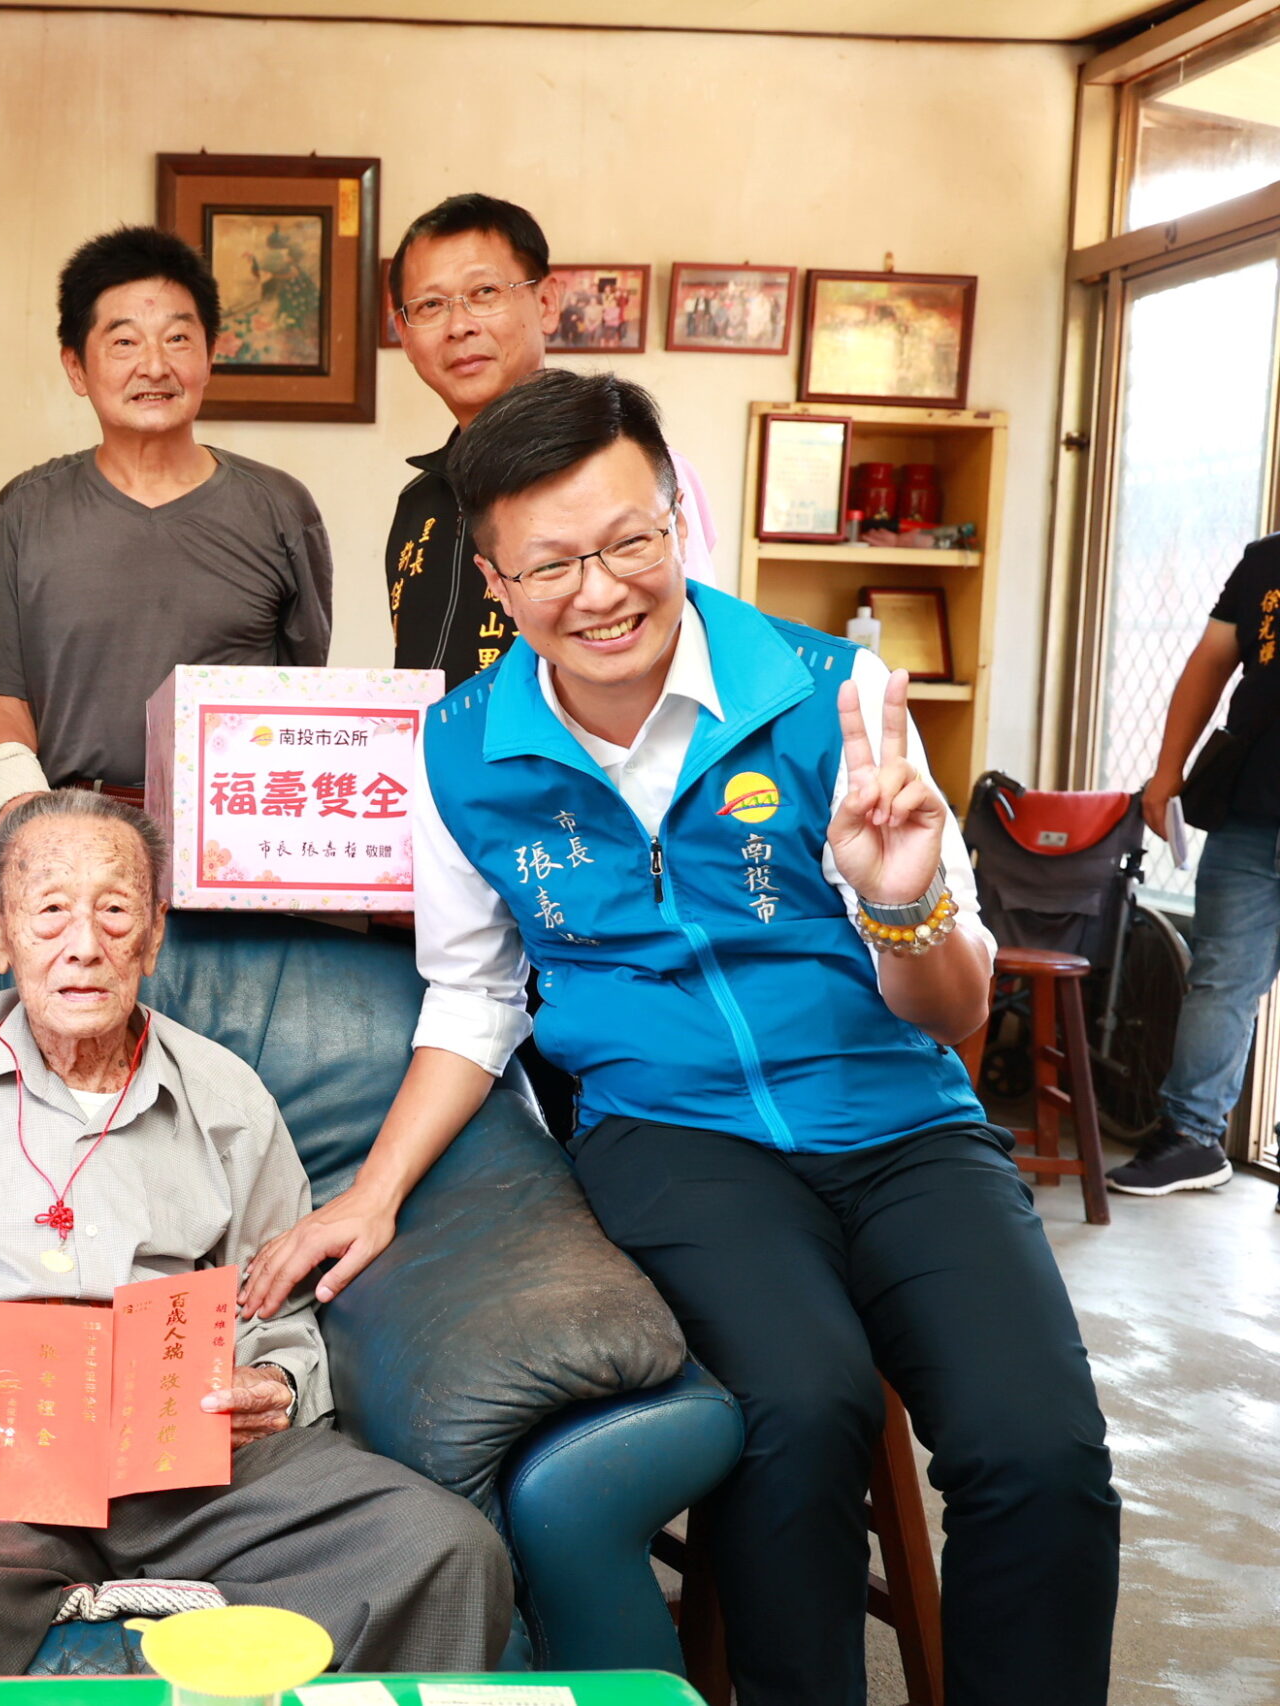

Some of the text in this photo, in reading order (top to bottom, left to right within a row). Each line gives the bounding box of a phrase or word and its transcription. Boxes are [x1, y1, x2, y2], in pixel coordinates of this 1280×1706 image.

[279, 729, 368, 747] 南投市公所
[209, 770, 409, 819] 福壽雙全
[365, 844, 393, 859] 敬贈
[552, 810, 595, 868] 市長
[741, 833, 780, 924] 南投市
[162, 1292, 190, 1361] 百歲人瑞
